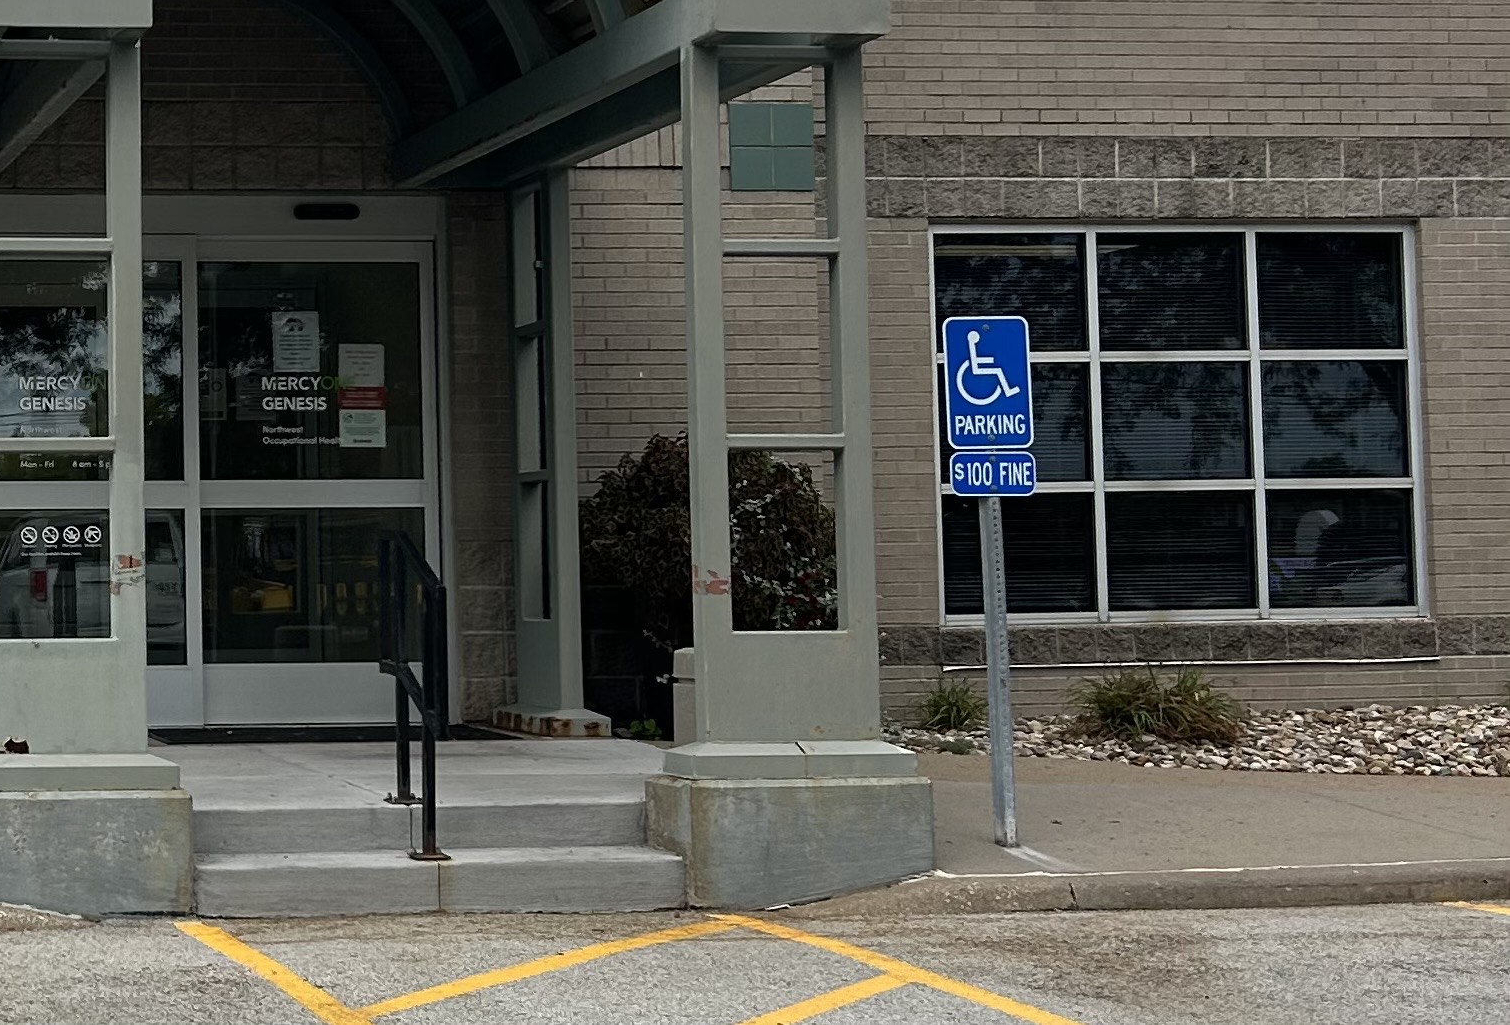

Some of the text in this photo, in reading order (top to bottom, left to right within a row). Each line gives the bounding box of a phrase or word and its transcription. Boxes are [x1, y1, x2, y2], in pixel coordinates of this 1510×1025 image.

[19, 376, 106, 391] MERCYON
[20, 397, 87, 411] GENESIS
[262, 396, 328, 411] GENESIS
[262, 425, 304, 434] Northwest
[954, 413, 1026, 436] PARKING
[262, 436, 318, 446] Occupational
[20, 460, 38, 468] Mon
[954, 462, 1033, 486] $100 FINE
